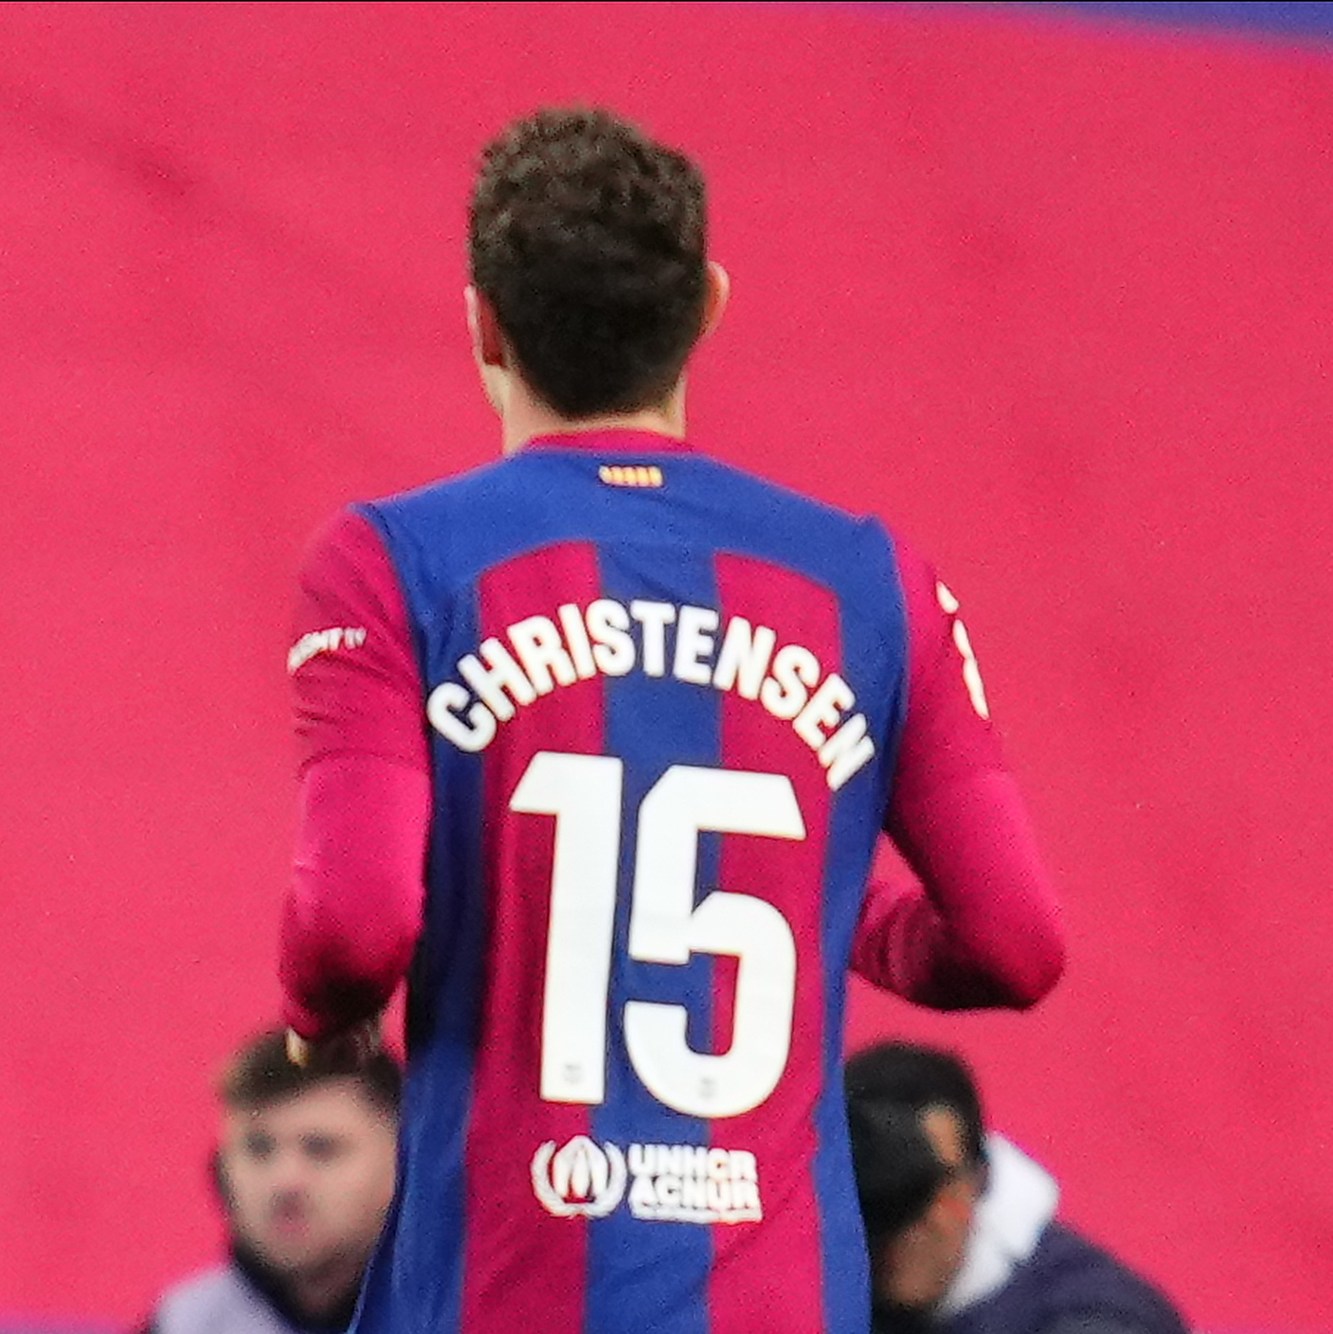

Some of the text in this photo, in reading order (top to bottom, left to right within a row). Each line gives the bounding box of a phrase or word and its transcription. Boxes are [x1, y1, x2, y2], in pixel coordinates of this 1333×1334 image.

[428, 599, 876, 791] CHRISTENSEN
[509, 751, 806, 1118] 15
[627, 1143, 758, 1179] UNHCR
[627, 1174, 761, 1210] ACNUR
